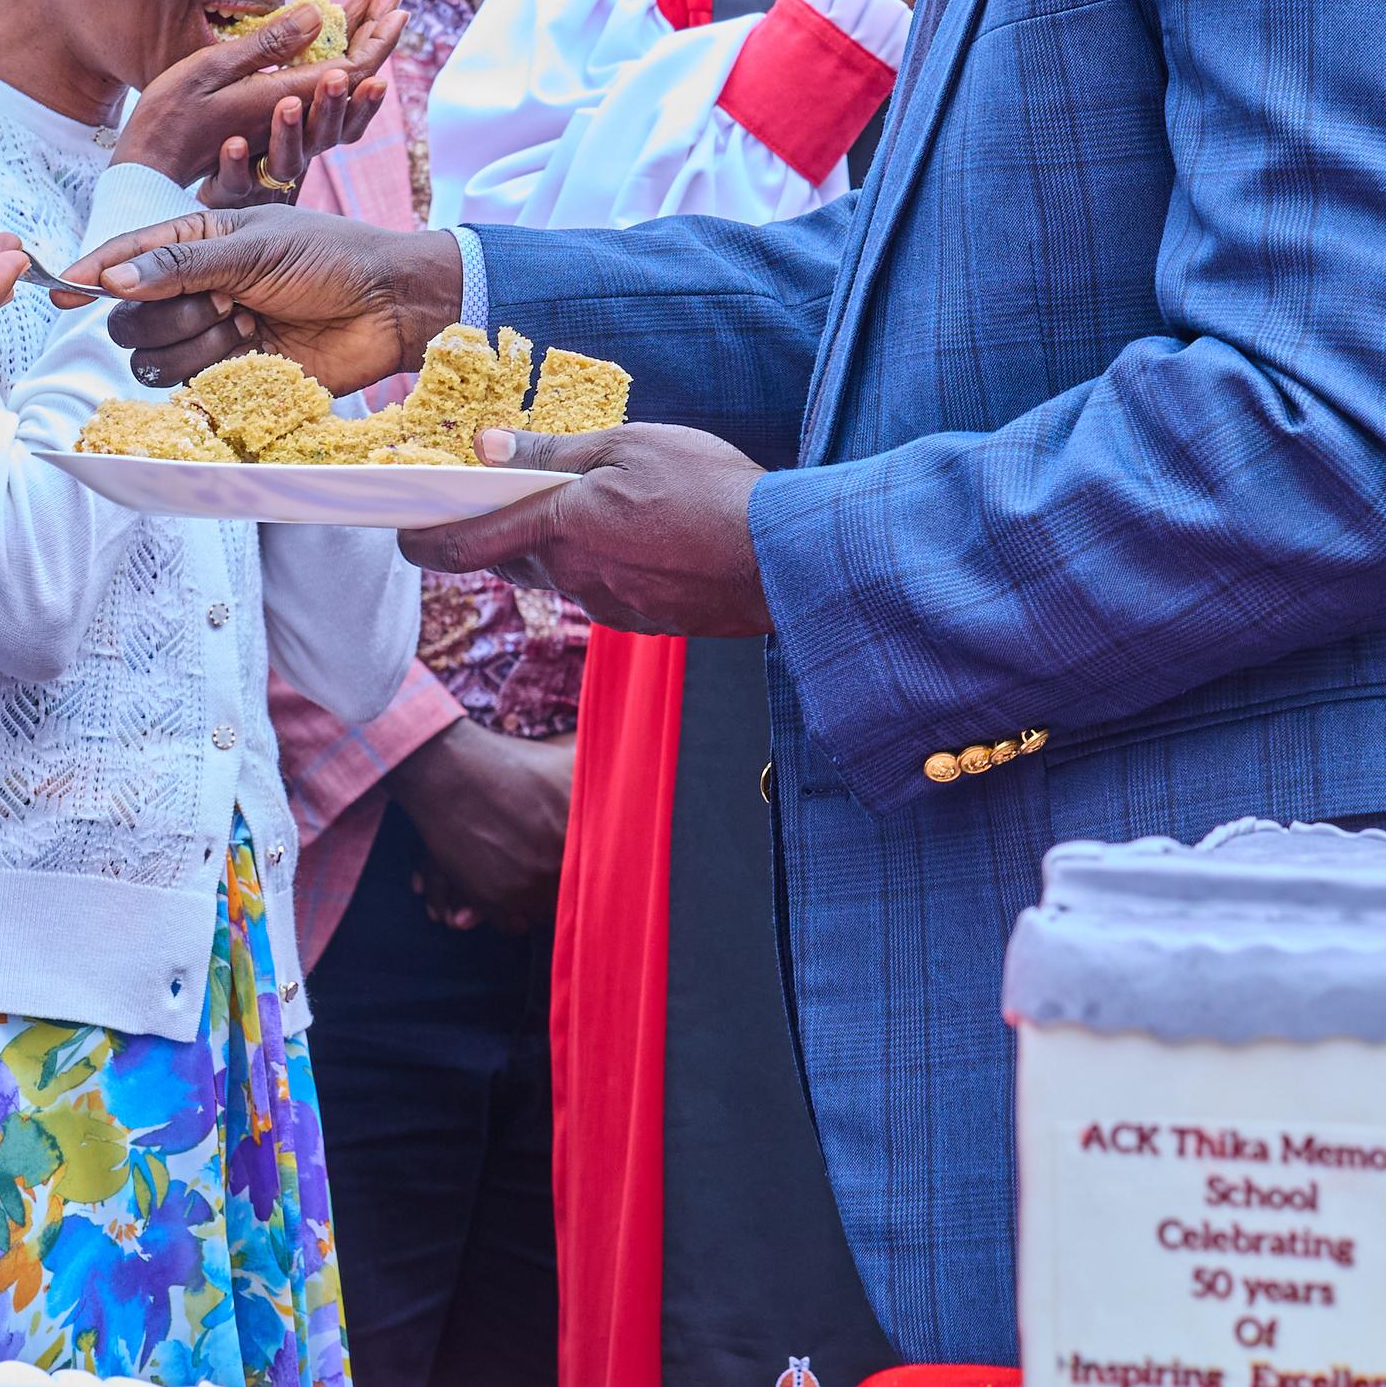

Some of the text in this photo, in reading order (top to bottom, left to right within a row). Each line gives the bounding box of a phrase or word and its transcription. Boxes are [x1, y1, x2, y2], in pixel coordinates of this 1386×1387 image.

[1080, 1122, 1159, 1156] ACK
[1170, 1126, 1270, 1163] Thika
[1205, 1174, 1318, 1212] School
[1156, 1217, 1354, 1268] Celebrating
[1191, 1266, 1335, 1306] 50 years
[1233, 1316, 1277, 1348] Of
